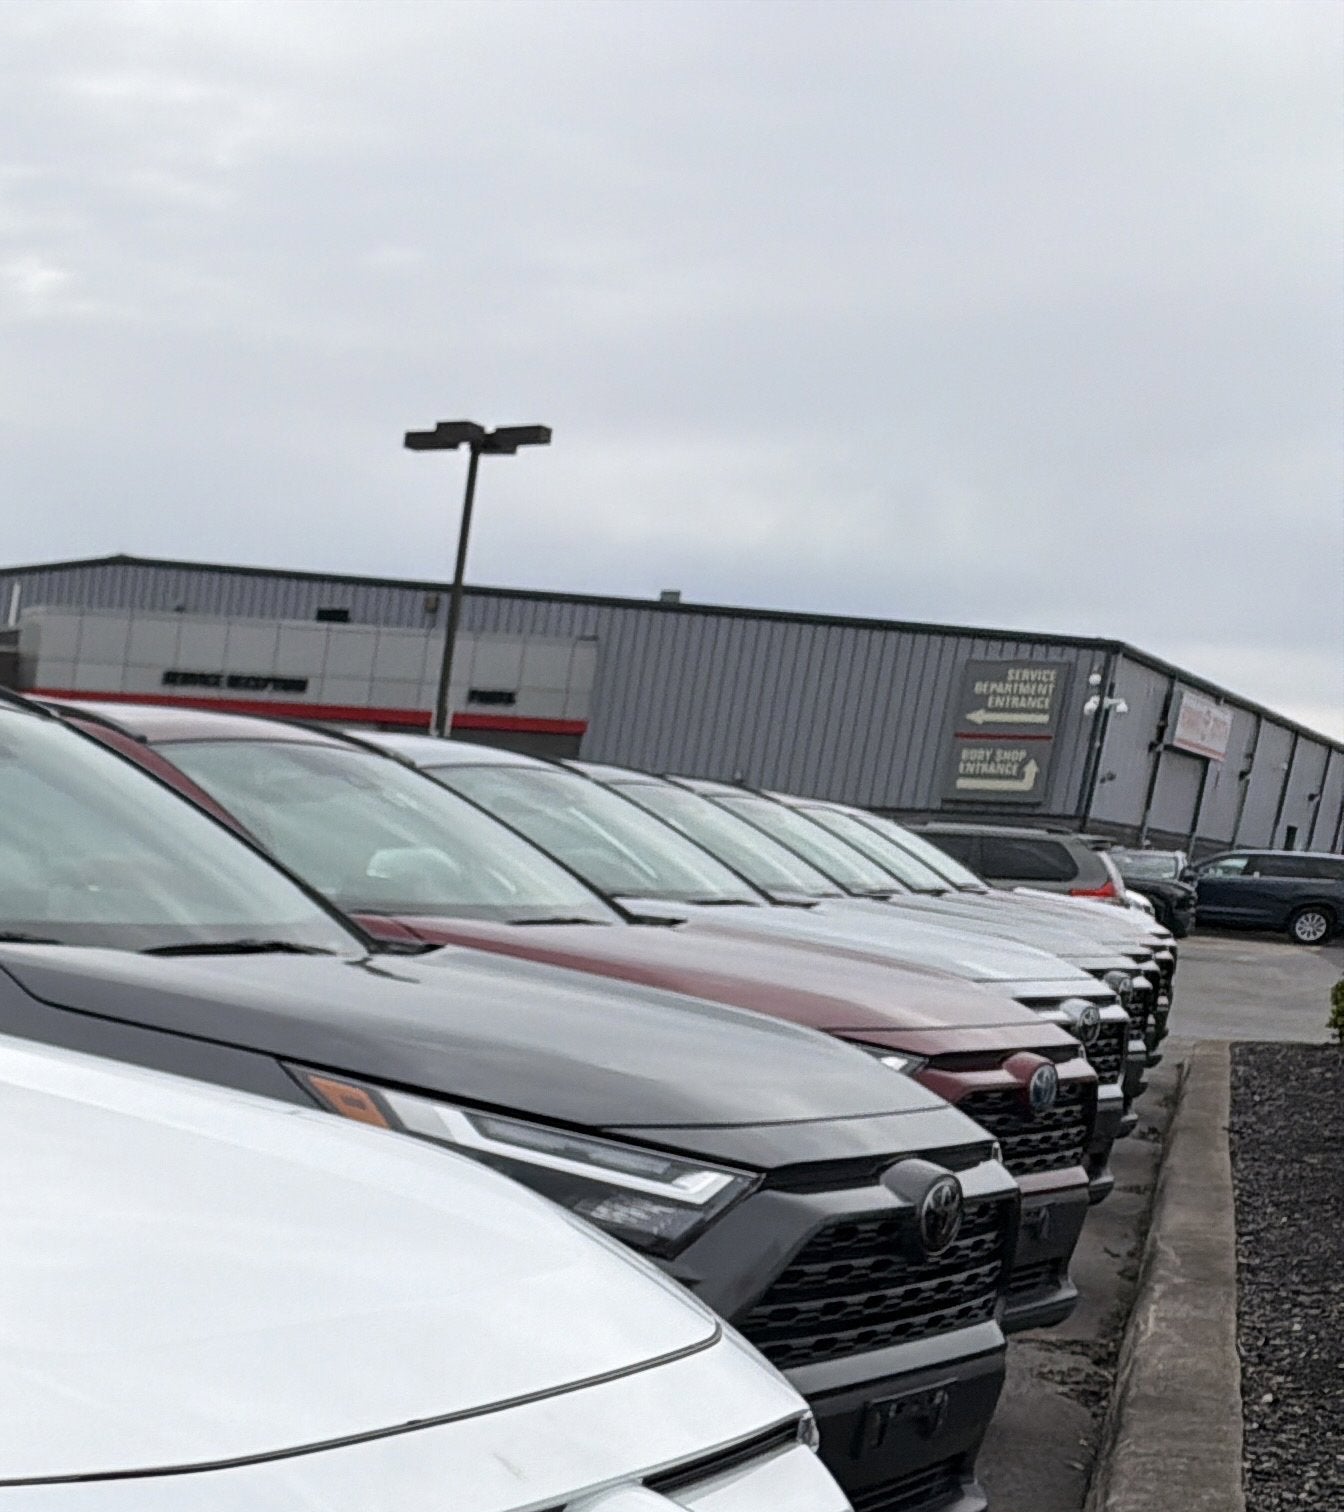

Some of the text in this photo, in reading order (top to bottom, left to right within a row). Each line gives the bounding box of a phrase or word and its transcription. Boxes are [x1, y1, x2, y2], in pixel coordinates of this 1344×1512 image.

[1006, 667, 1057, 682] SERVICE
[974, 681, 1056, 697] DEPARTMENT
[987, 695, 1050, 709] ENTRANCE
[961, 747, 1027, 762] BODY SHOP
[958, 761, 1018, 776] ENTRANCE
